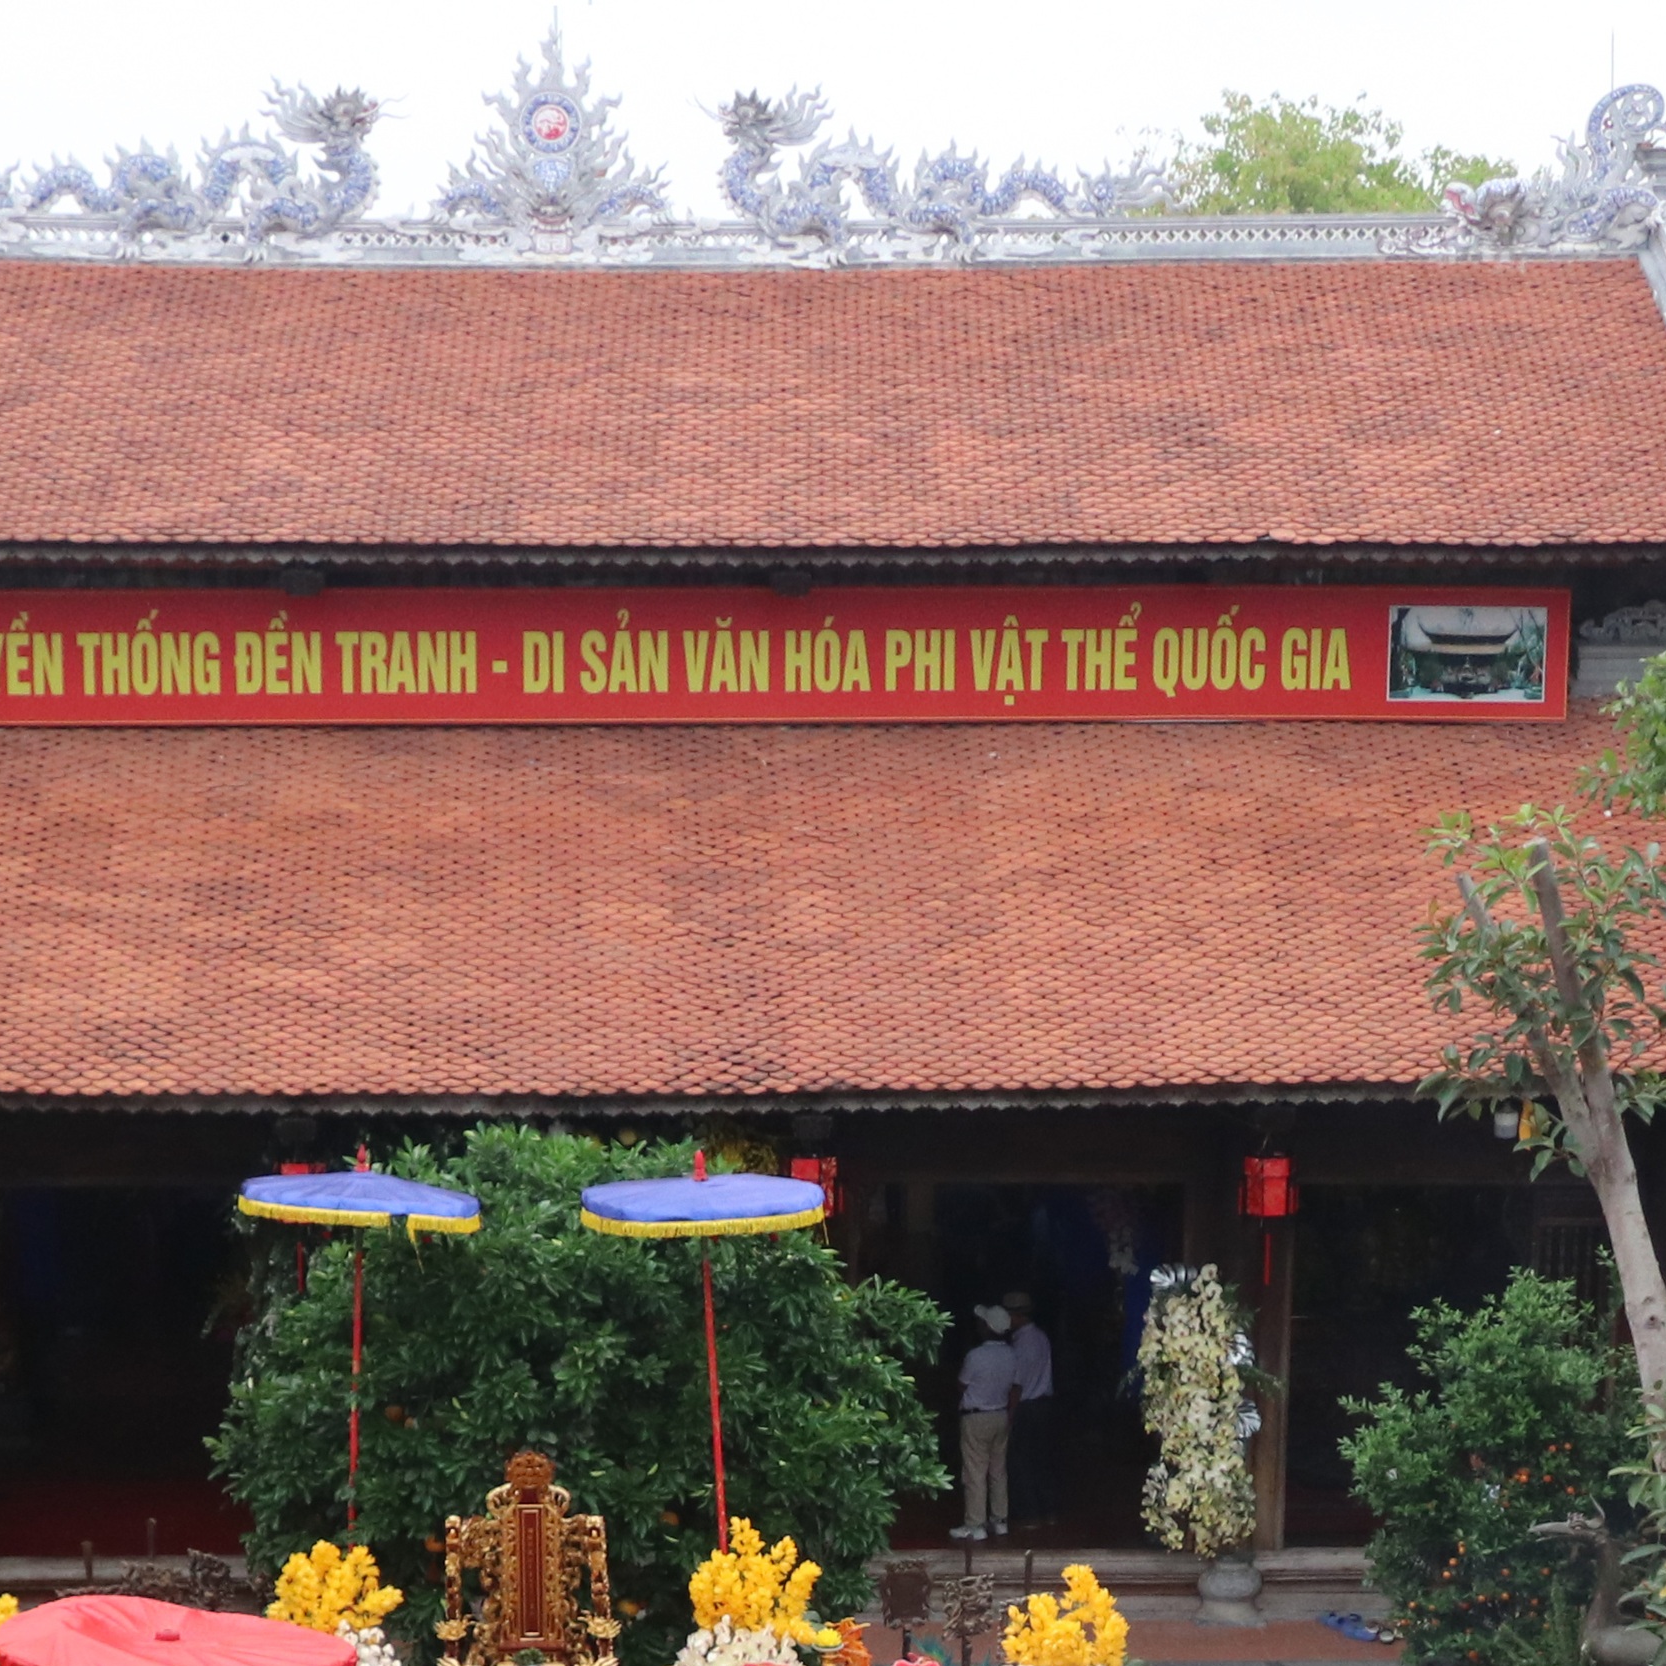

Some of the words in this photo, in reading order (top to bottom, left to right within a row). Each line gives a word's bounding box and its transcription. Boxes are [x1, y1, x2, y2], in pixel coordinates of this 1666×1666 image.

[76, 608, 221, 696] THỐNG
[234, 613, 322, 695] ĐỀN
[335, 631, 478, 694] TRANH
[522, 631, 565, 694] DI
[579, 608, 669, 694] SẢN
[683, 616, 770, 693] VĂN
[784, 616, 871, 693] HÓA
[884, 629, 956, 692] PHI
[970, 615, 1049, 706] VẬT
[1061, 602, 1142, 692] THỂ
[1152, 605, 1267, 698] QUỐC
[1280, 628, 1351, 691] GIA
